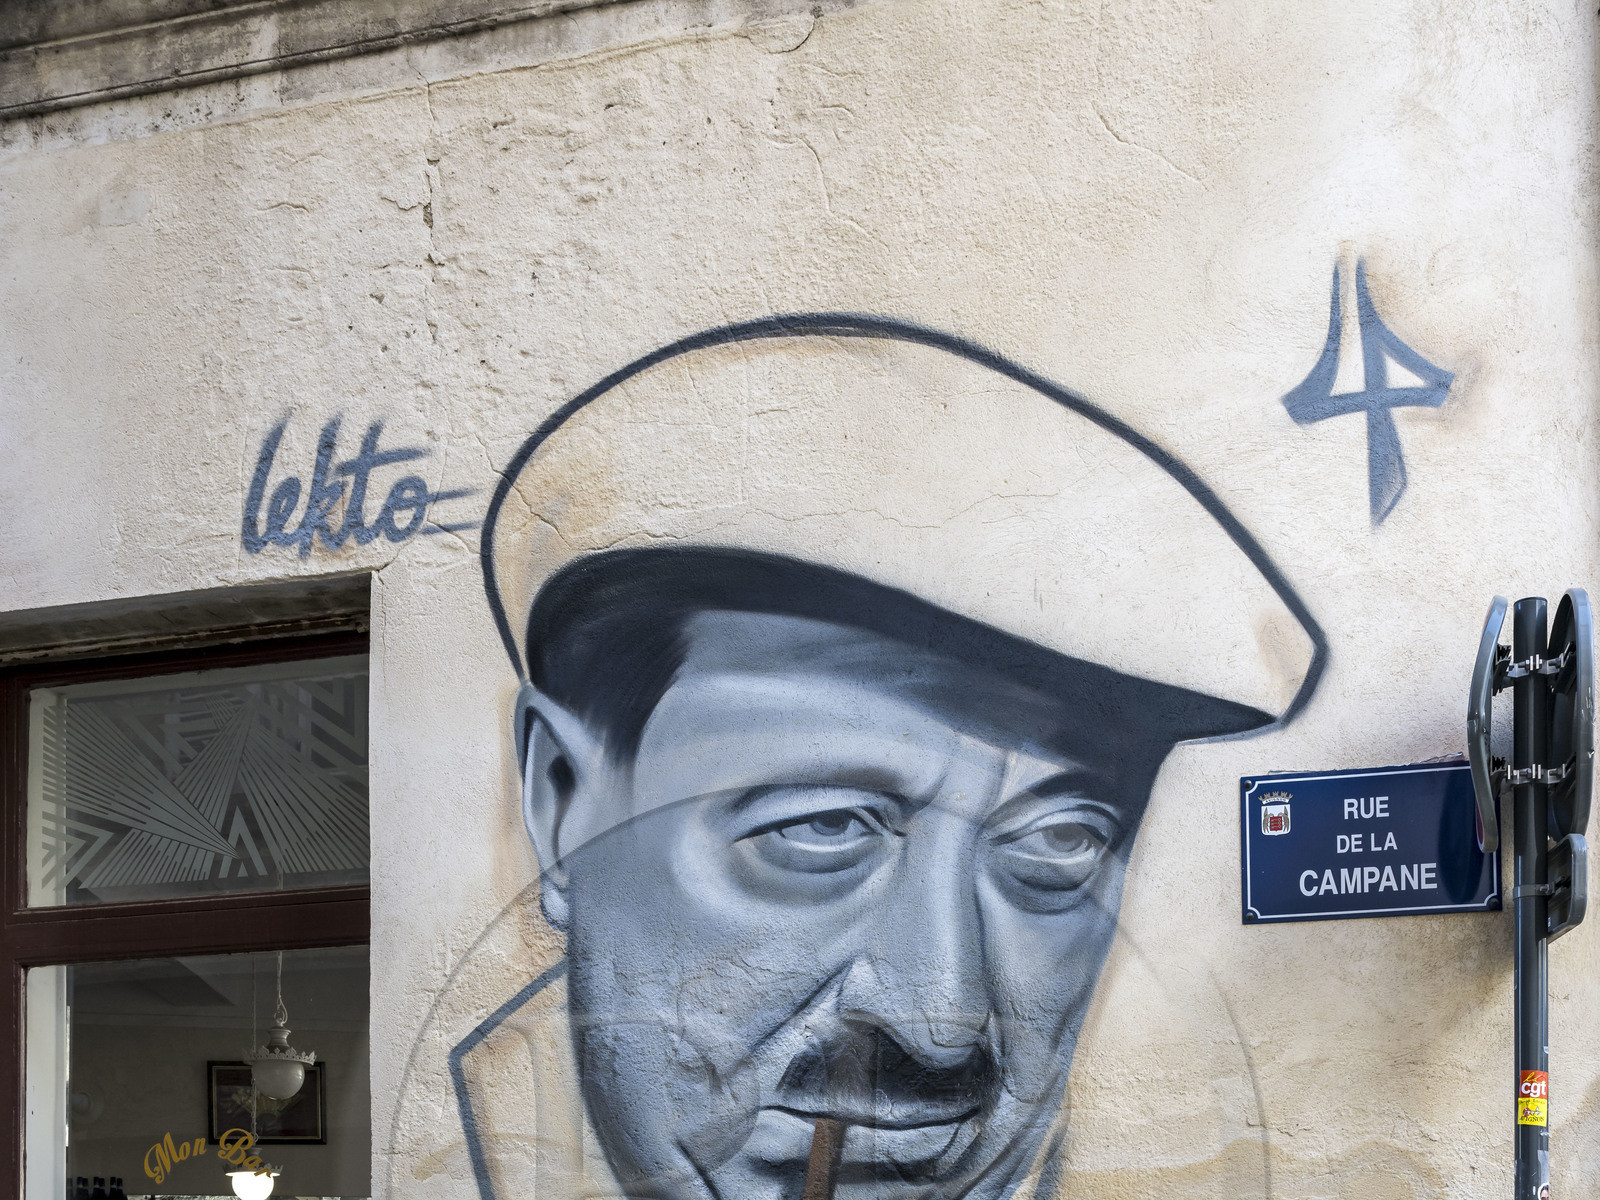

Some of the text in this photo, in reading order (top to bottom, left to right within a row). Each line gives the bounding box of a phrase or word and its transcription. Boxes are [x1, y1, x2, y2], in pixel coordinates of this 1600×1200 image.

[1343, 796, 1390, 819] RUE
[1336, 832, 1398, 854] DE LA
[1299, 862, 1438, 897] CAMPANE
[1521, 1080, 1546, 1097] cgt
[144, 1128, 271, 1184] Mon Bar
